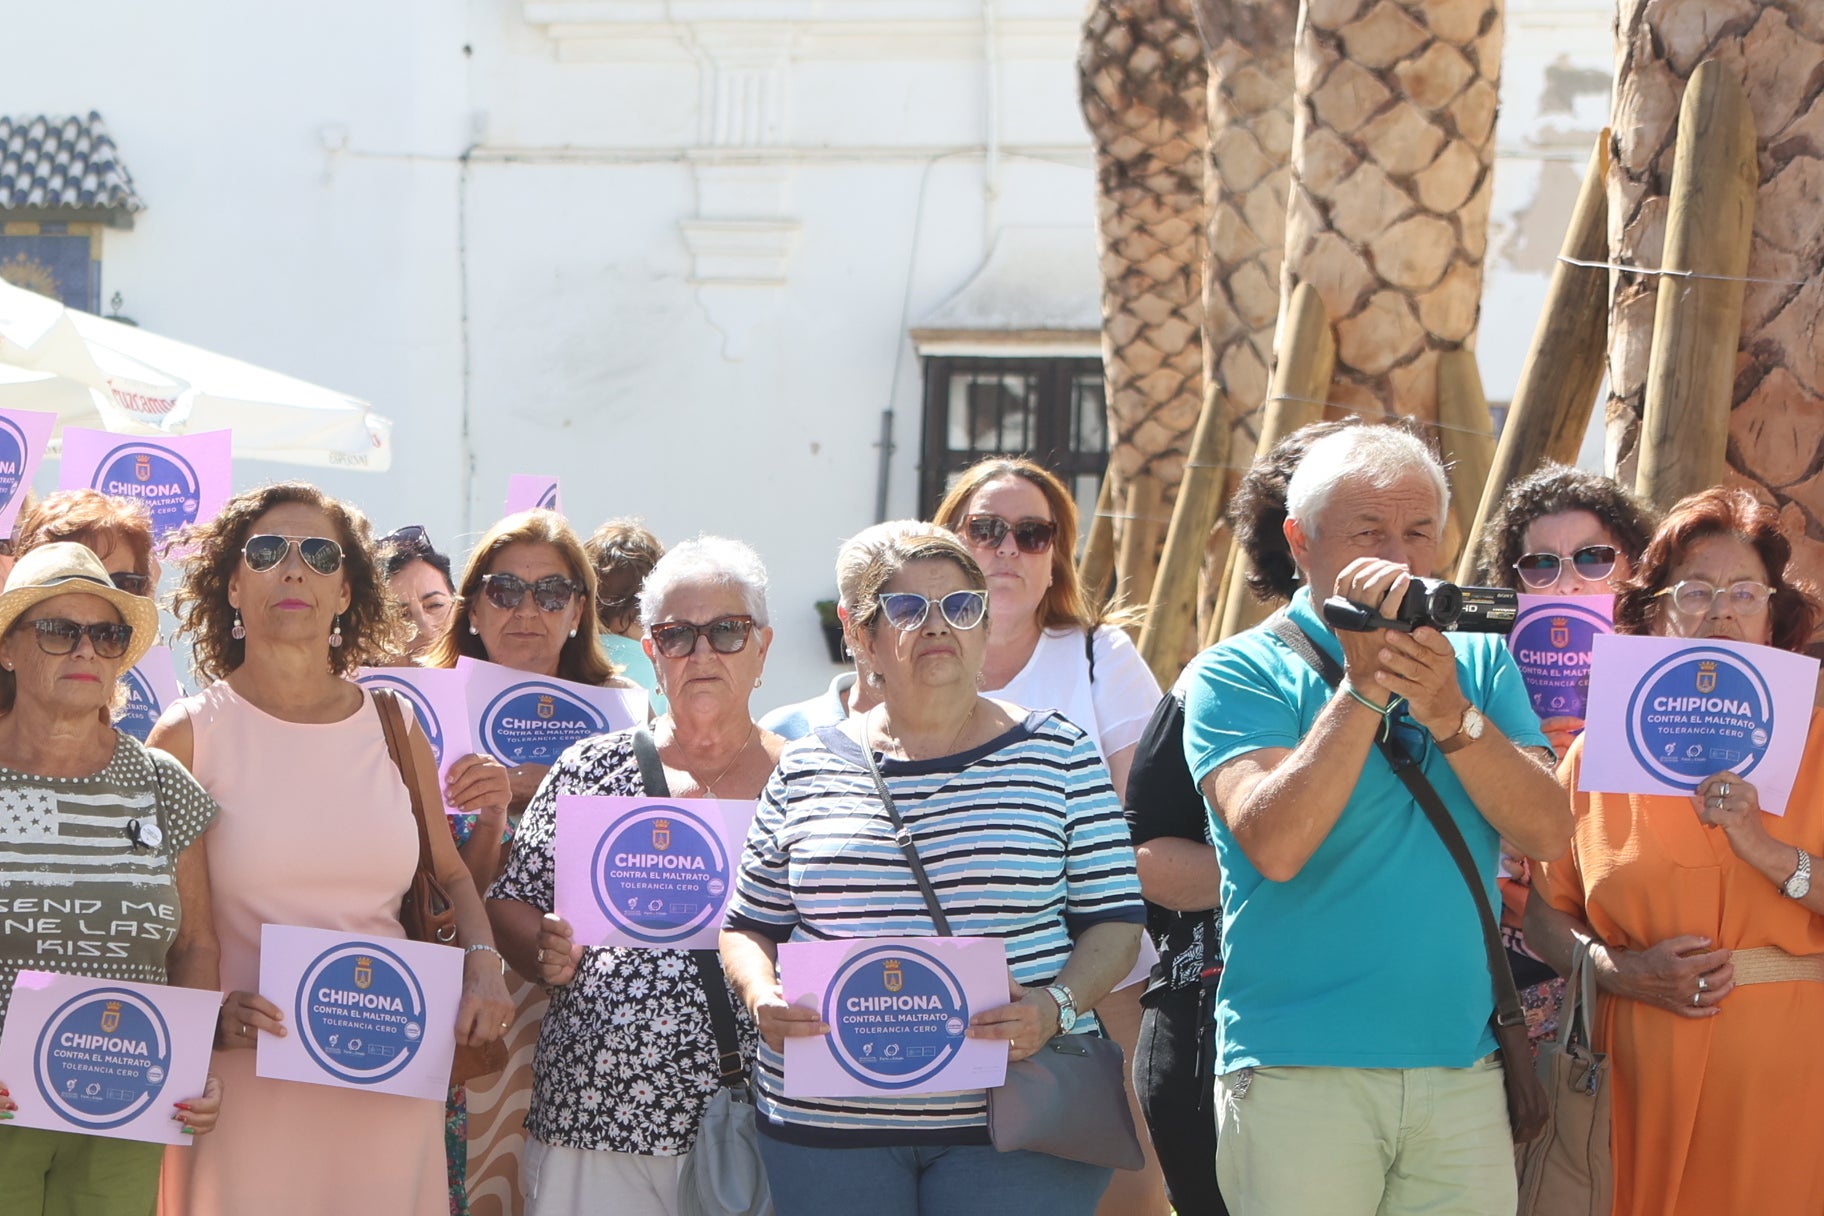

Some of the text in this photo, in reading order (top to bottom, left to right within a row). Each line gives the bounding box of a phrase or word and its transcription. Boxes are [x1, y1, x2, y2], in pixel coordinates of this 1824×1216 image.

[109, 481, 181, 497] CHIPIONA
[1520, 649, 1592, 666] CHIPION
[1550, 669, 1561, 677] EL
[1654, 697, 1752, 717] CHIPIONA
[502, 718, 587, 729] CHIPIONA
[1648, 715, 1687, 723] CONTRA
[1705, 716, 1755, 730] MALTRATO
[1658, 727, 1715, 735] TOLERANCIA
[1719, 729, 1744, 738] CERO
[615, 853, 705, 870] CHIPIONA
[610, 871, 647, 879] CONTRA
[663, 872, 710, 880] MALTRATO
[621, 882, 673, 890] TOLERANCIA
[122, 900, 175, 920] ME
[79, 919, 176, 942] LAST
[37, 939, 131, 958] KISS
[318, 988, 403, 1012] CHIPIONA
[846, 995, 942, 1012] CHIPIONA
[313, 1005, 407, 1024] CONTRA EL MALTRATO
[843, 1014, 948, 1024] CONTRA EL MALTRATO
[323, 1018, 372, 1030] TOLERANCIA
[376, 1025, 397, 1033] CERO
[854, 1026, 909, 1034] TOLERANCIA
[61, 1032, 148, 1056] CHIPIONA
[54, 1050, 150, 1068] CONTRA EL MALTRATO
[62, 1063, 113, 1074] TOLERANCIA
[117, 1070, 139, 1078] CERO
